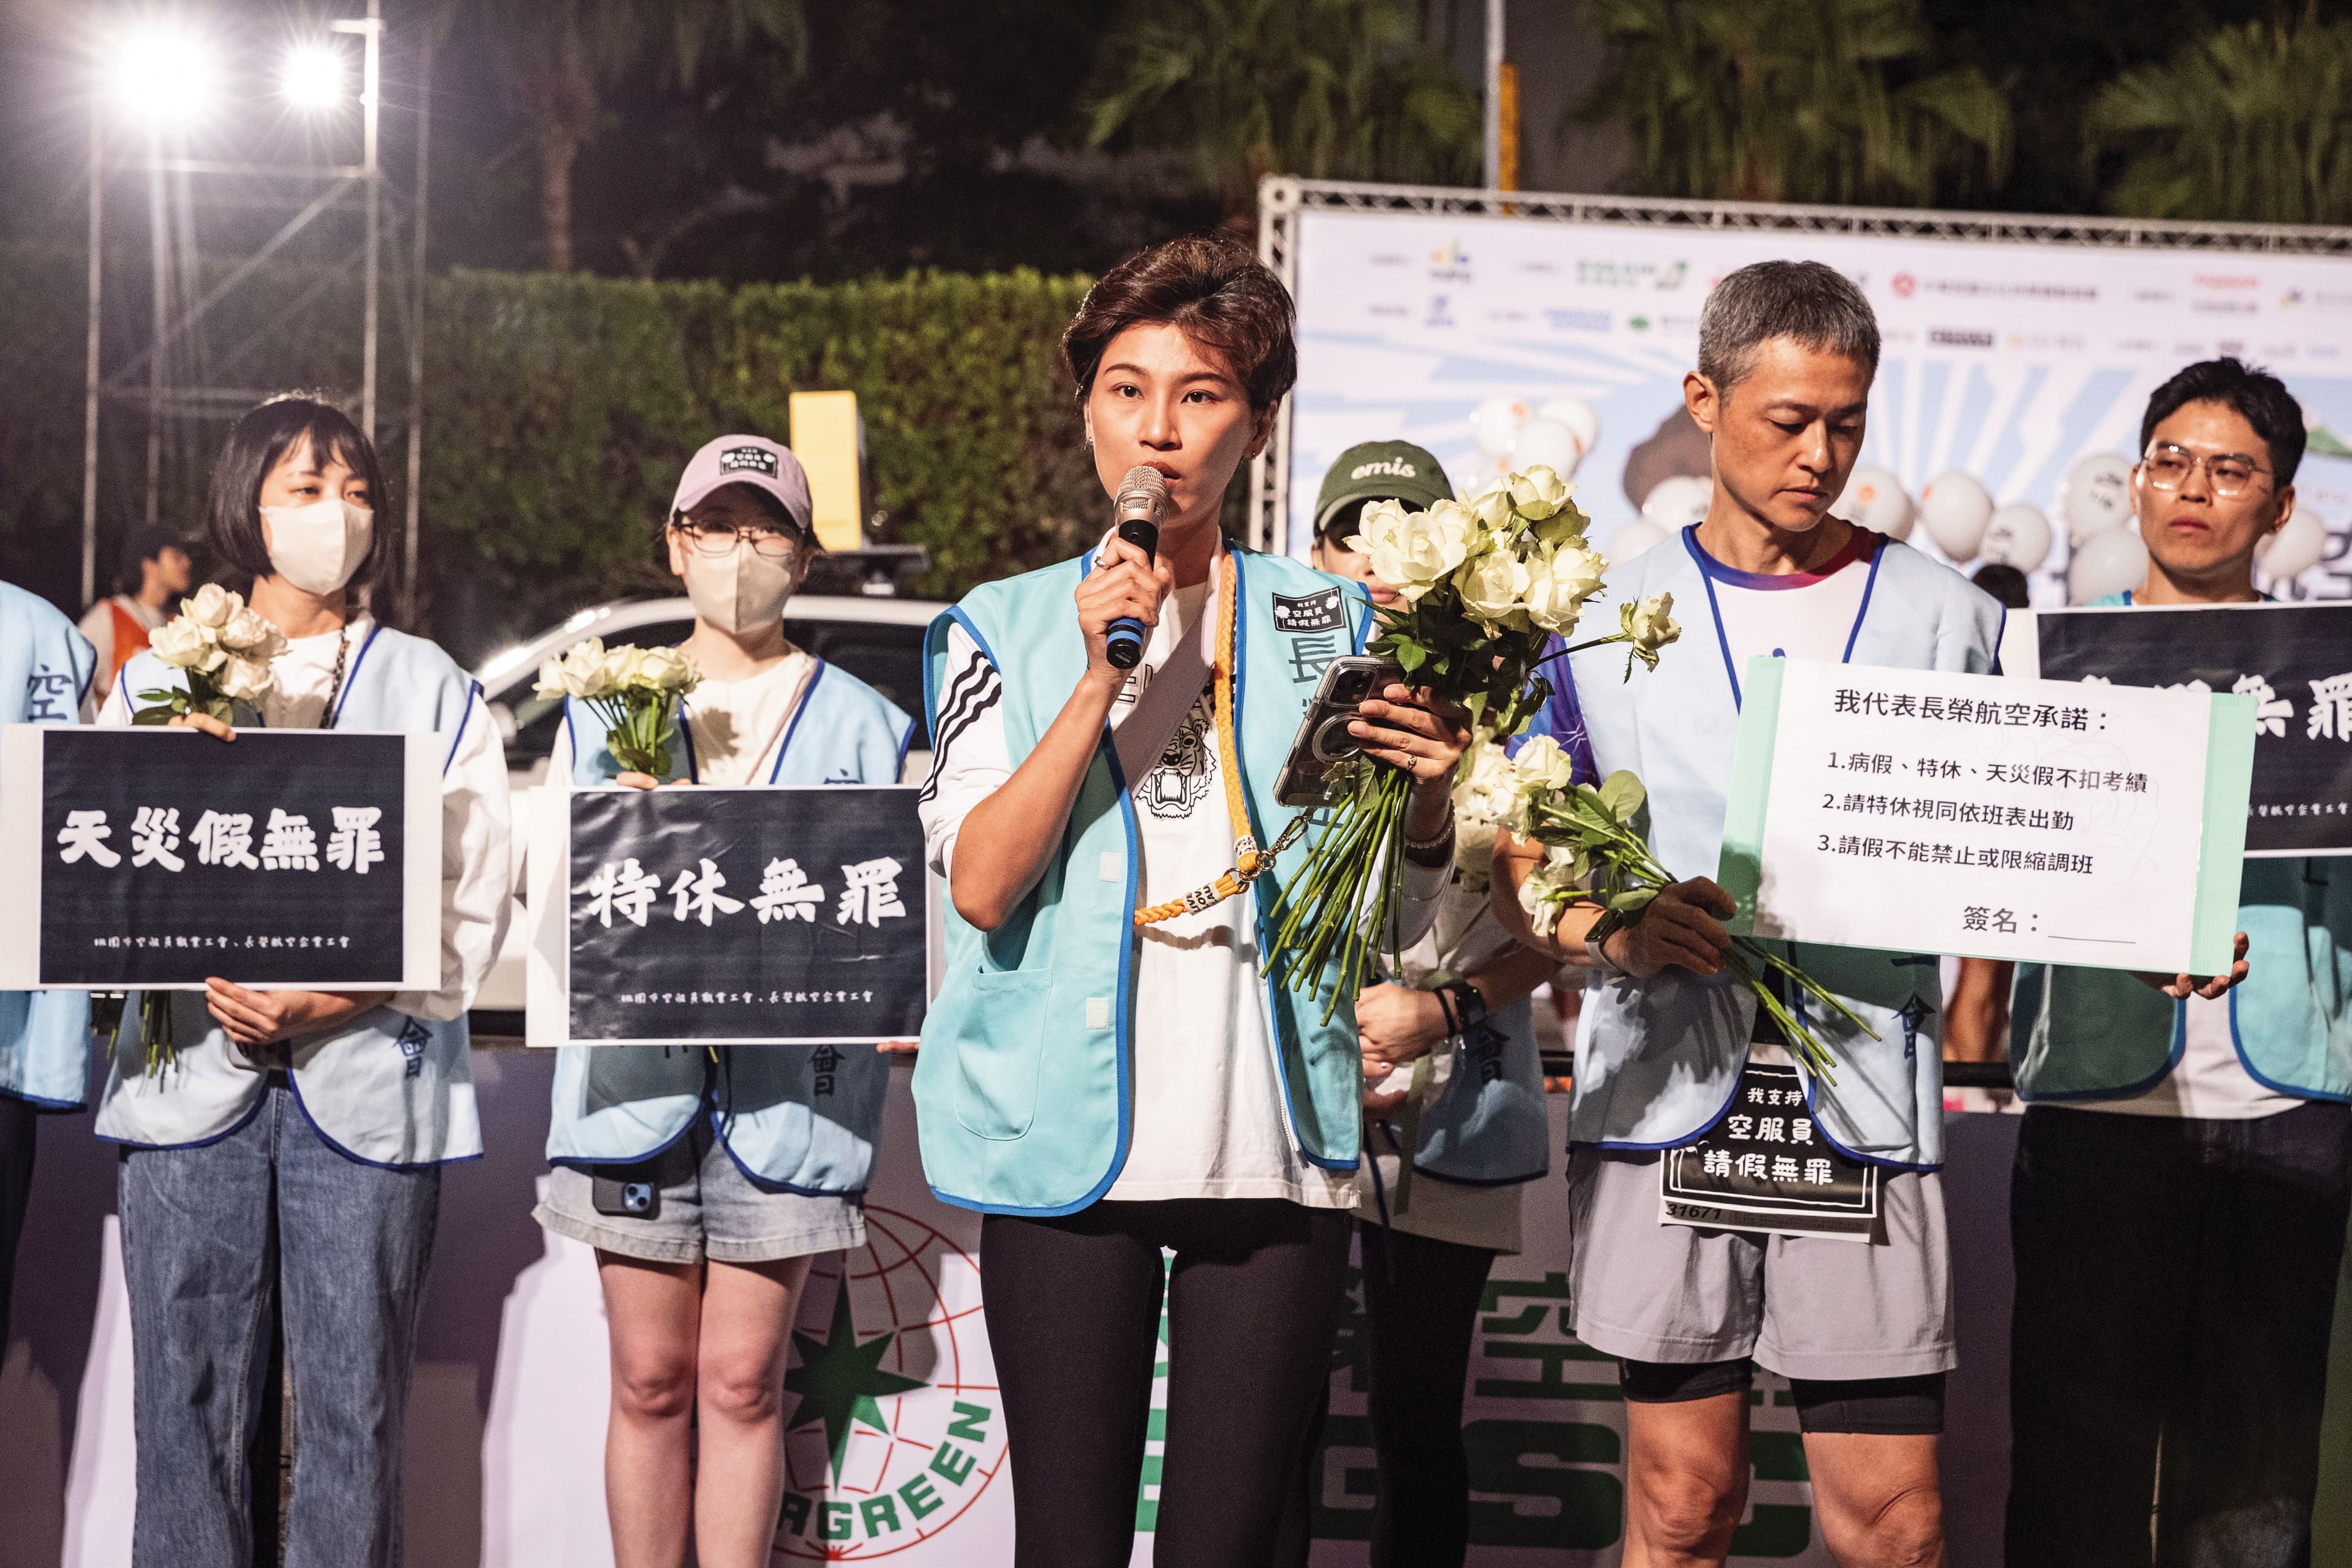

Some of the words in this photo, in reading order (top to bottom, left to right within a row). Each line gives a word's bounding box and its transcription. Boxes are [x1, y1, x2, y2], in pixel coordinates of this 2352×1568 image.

[1351, 456, 1416, 480] emis
[1287, 615, 1332, 627] 請假無罪
[1834, 688, 2107, 732] 我代表長榮航空承諾：
[1828, 752, 2148, 794] 1.病假、特休、天災假不扣考績
[1822, 793, 2074, 832] 2.請特休視同依班表出勤
[57, 806, 385, 874] 天災假無罪
[1817, 834, 2094, 875] 3.請假不能禁止或限縮調班
[588, 857, 907, 928] 特休無罪
[1747, 1087, 1803, 1107] 我支持
[1727, 1114, 1814, 1146] 空服員
[1703, 1149, 1834, 1186] 請假無罪
[1665, 1203, 1722, 1219] 31671
